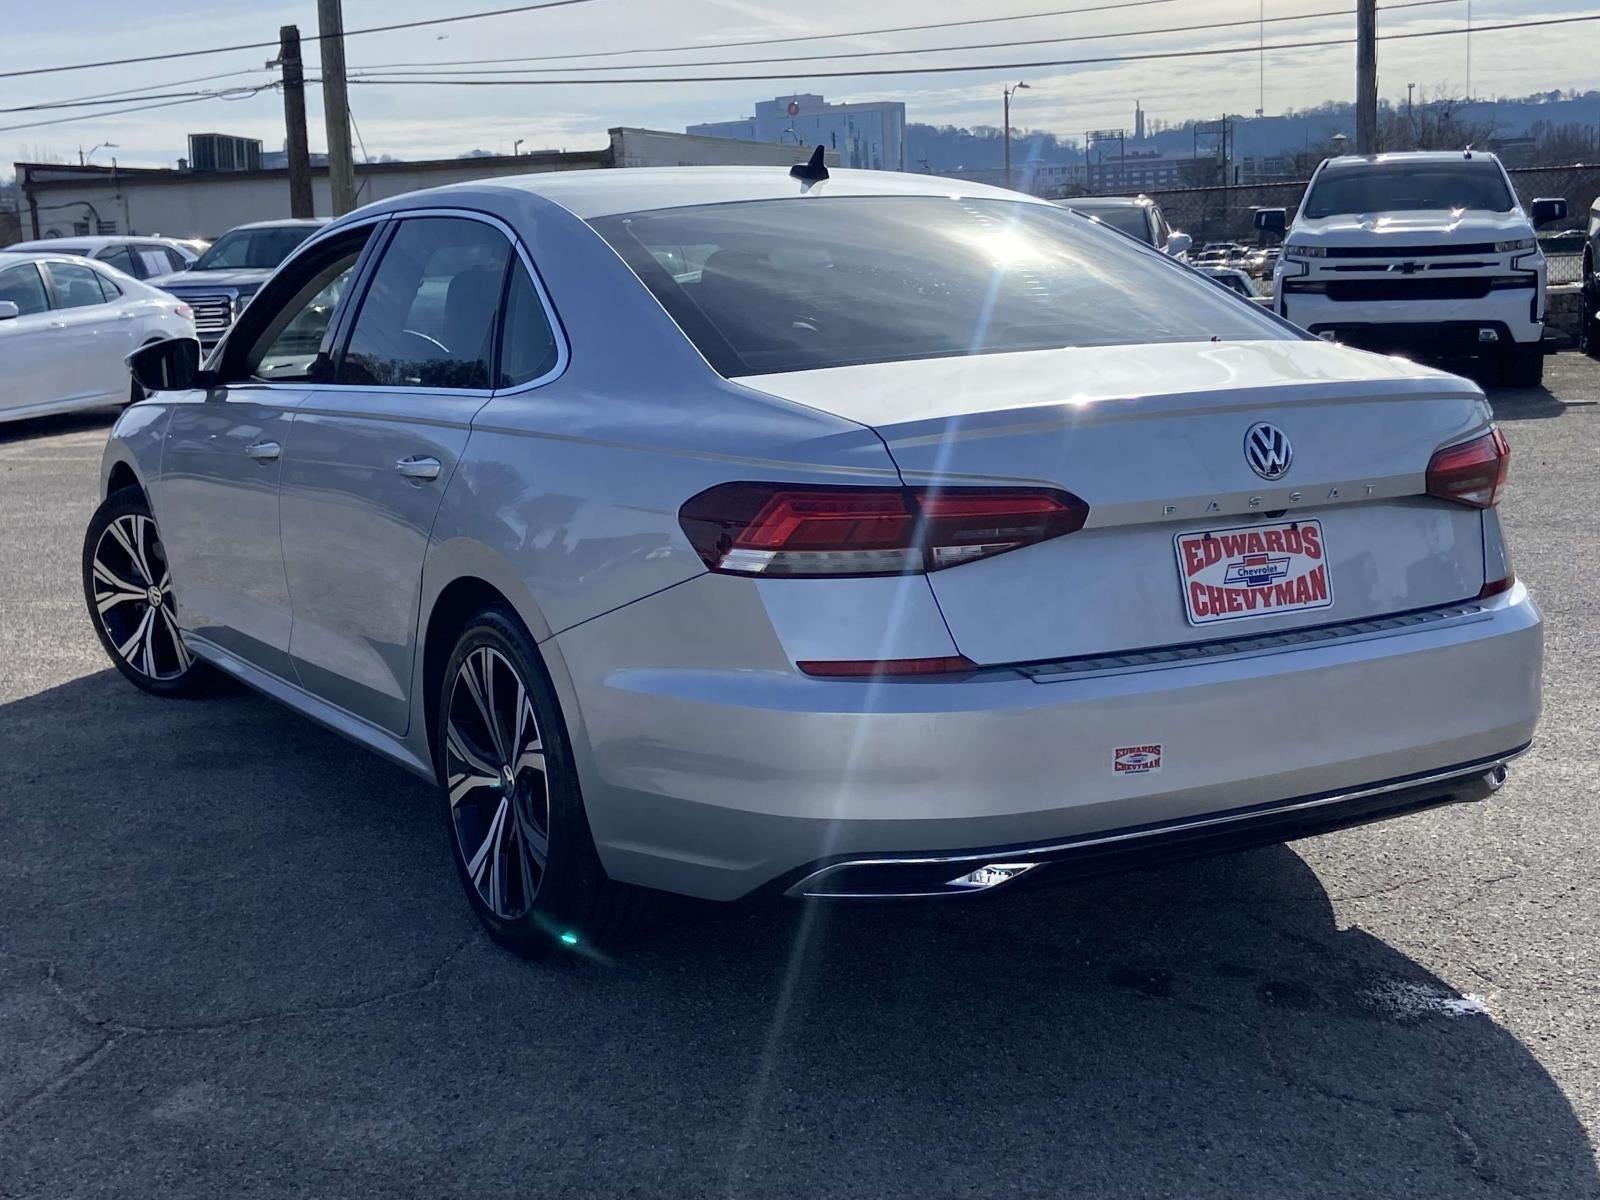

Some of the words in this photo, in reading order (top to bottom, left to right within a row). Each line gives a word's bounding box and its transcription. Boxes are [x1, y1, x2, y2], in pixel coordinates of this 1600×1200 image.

[1162, 484, 1375, 516] PASSAT
[1182, 525, 1322, 577] EDWARDS
[1237, 564, 1278, 577] Chevrolet
[1190, 564, 1328, 617] CHEVYMAN
[1115, 745, 1161, 760] EDWARDS
[1114, 757, 1161, 772] CHEVYMAN
